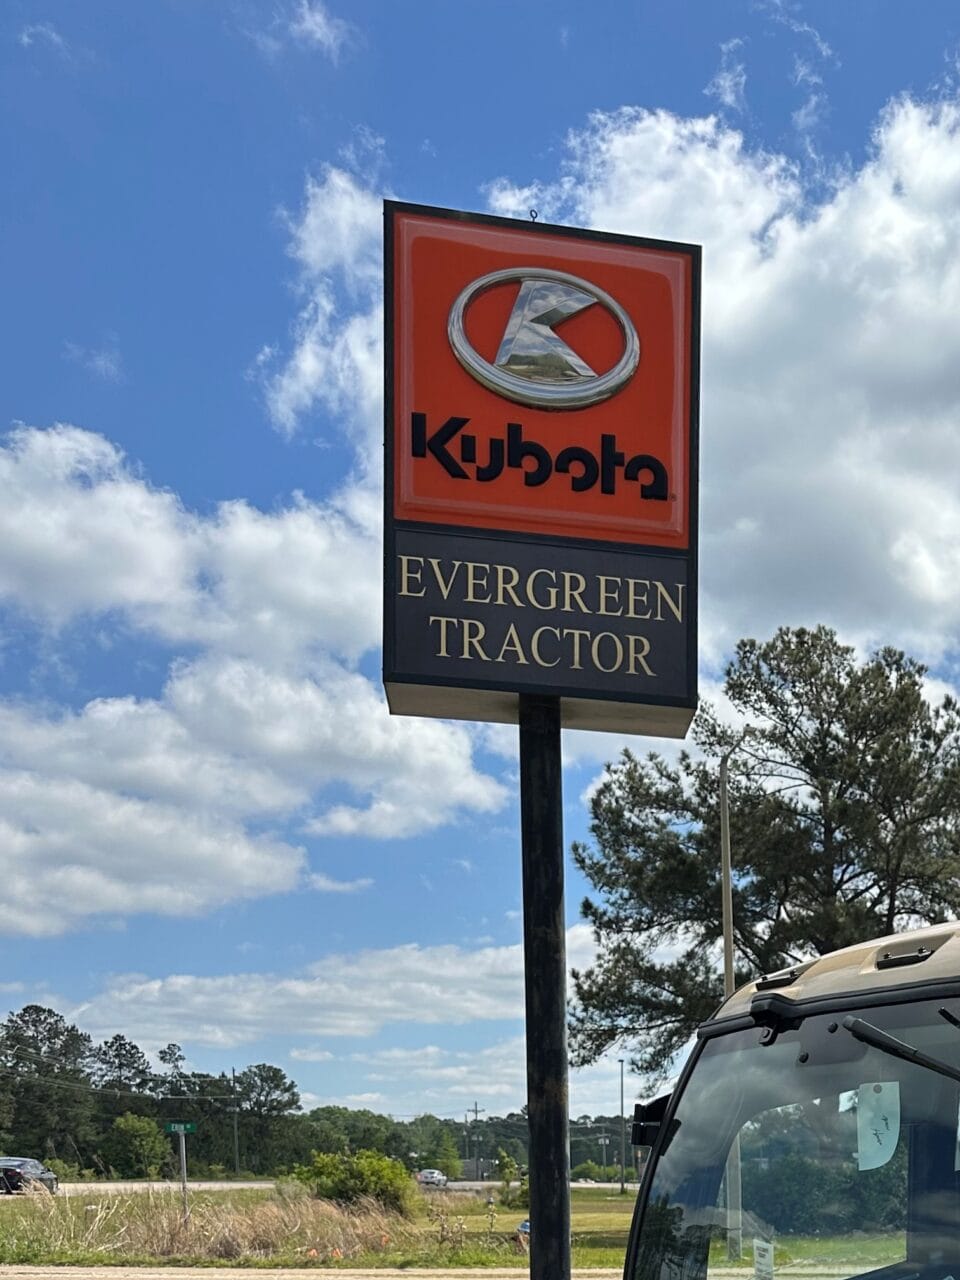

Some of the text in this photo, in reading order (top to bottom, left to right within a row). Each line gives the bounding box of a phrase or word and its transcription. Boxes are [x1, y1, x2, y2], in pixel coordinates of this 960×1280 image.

[411, 412, 668, 501] Kubota
[397, 555, 686, 623] EVERGREEN
[429, 616, 657, 676] TRACTOR
